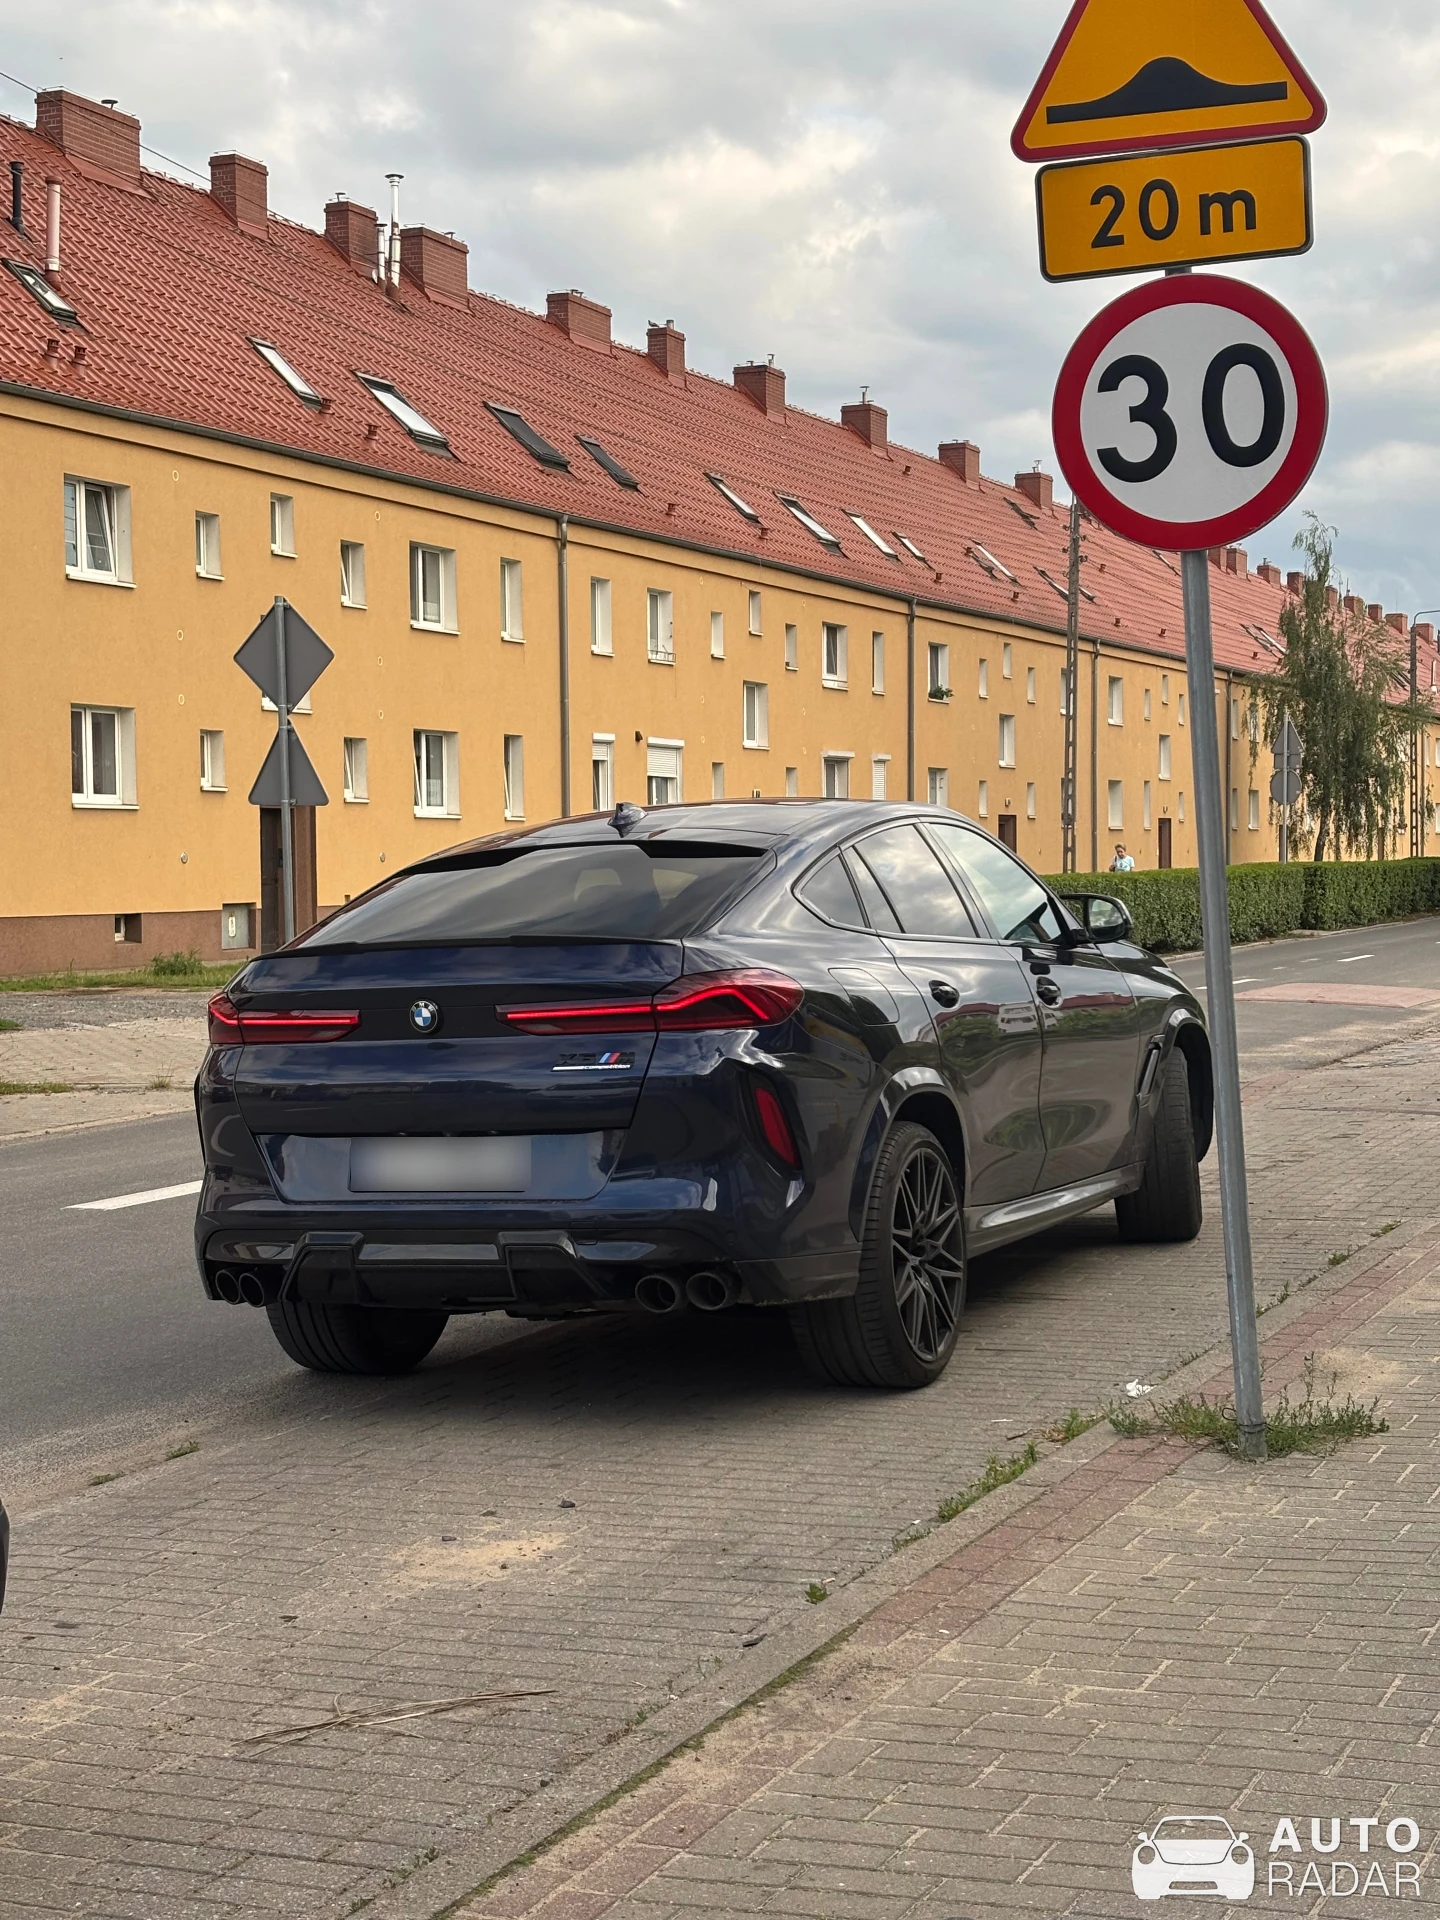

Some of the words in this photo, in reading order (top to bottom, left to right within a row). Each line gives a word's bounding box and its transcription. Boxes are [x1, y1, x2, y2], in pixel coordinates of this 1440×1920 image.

[1089, 178, 1179, 249] 20
[1198, 188, 1257, 236] m
[1096, 342, 1286, 483] 30
[410, 1001, 435, 1012] BMW
